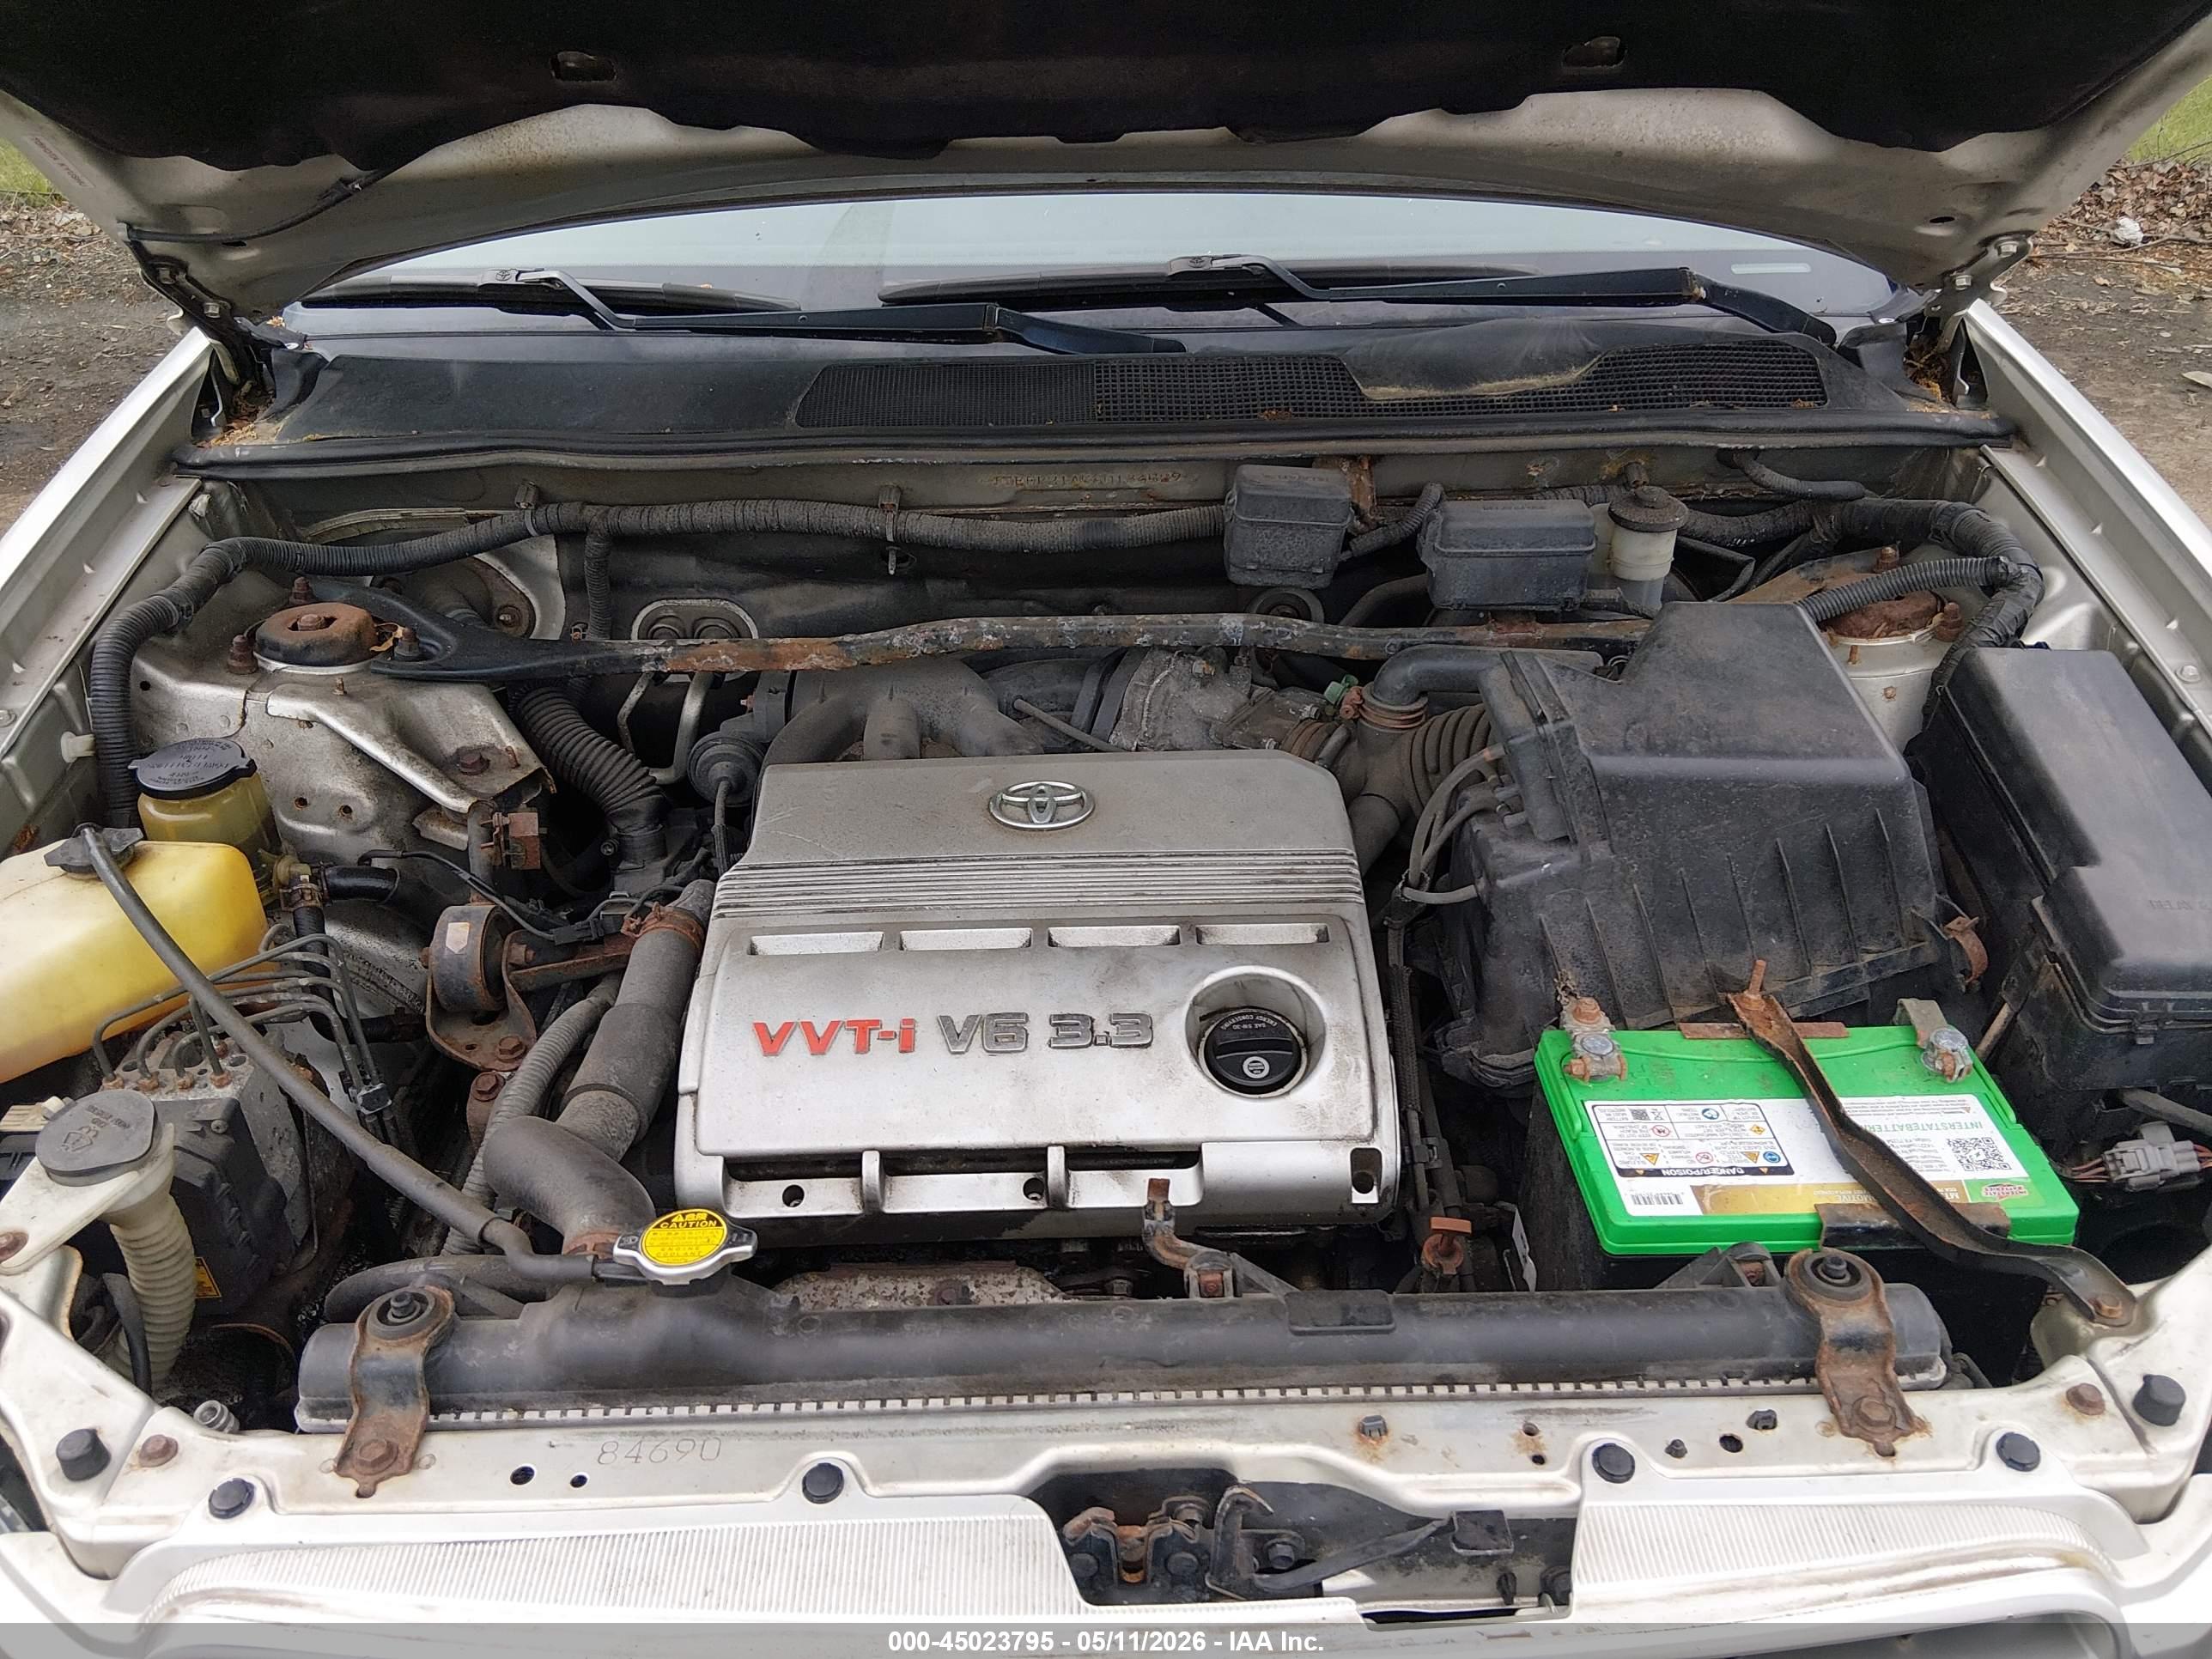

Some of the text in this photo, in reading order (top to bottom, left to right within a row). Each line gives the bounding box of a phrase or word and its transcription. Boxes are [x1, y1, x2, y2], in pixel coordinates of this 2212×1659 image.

[752, 1012, 1154, 1056] VVT-i V6 3.3
[659, 1220, 717, 1229] CAUTION
[597, 1437, 722, 1465] 84690
